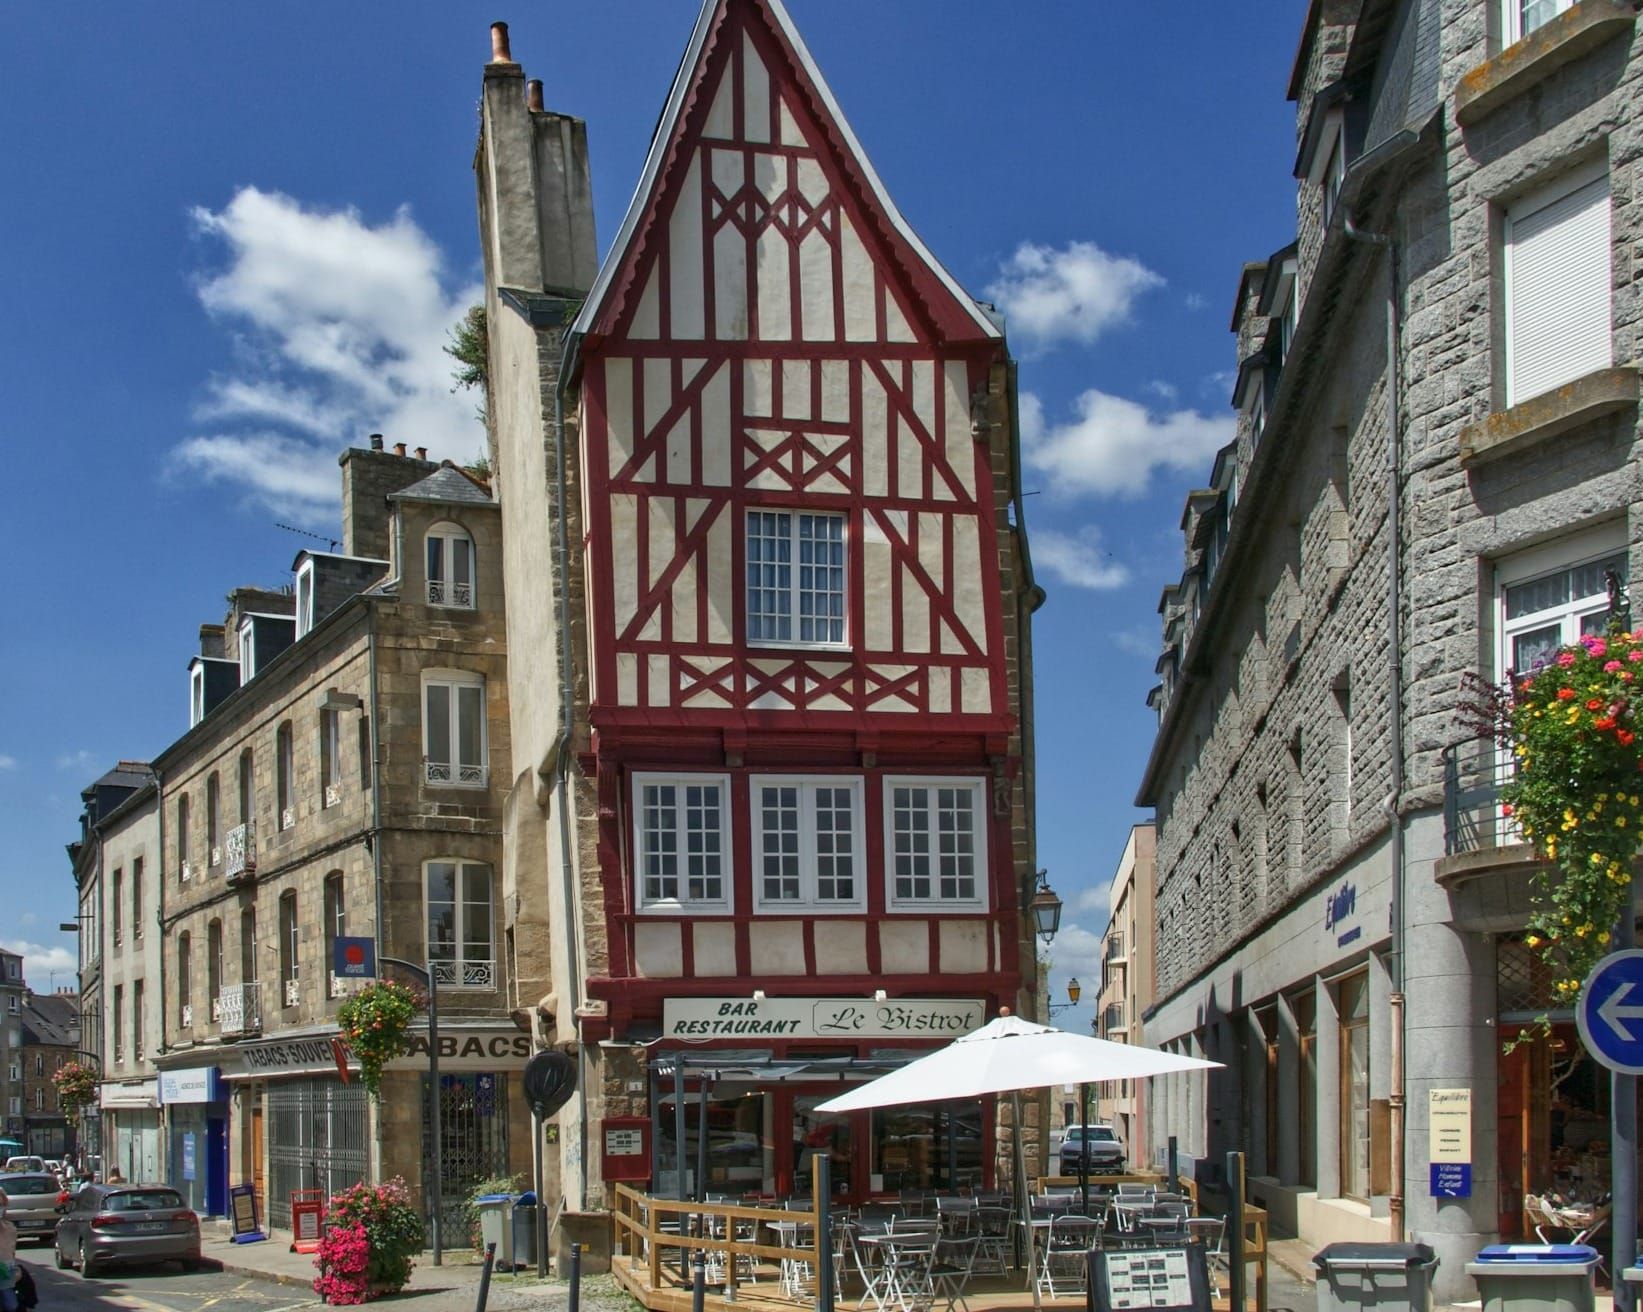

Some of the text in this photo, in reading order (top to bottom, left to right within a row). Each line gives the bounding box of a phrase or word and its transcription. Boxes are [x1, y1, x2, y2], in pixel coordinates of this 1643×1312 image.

[717, 1002, 759, 1016] BAR
[672, 1019, 801, 1034] RESTAURANT
[819, 1006, 975, 1031] Le Bistrot
[399, 1036, 531, 1058] ABACS
